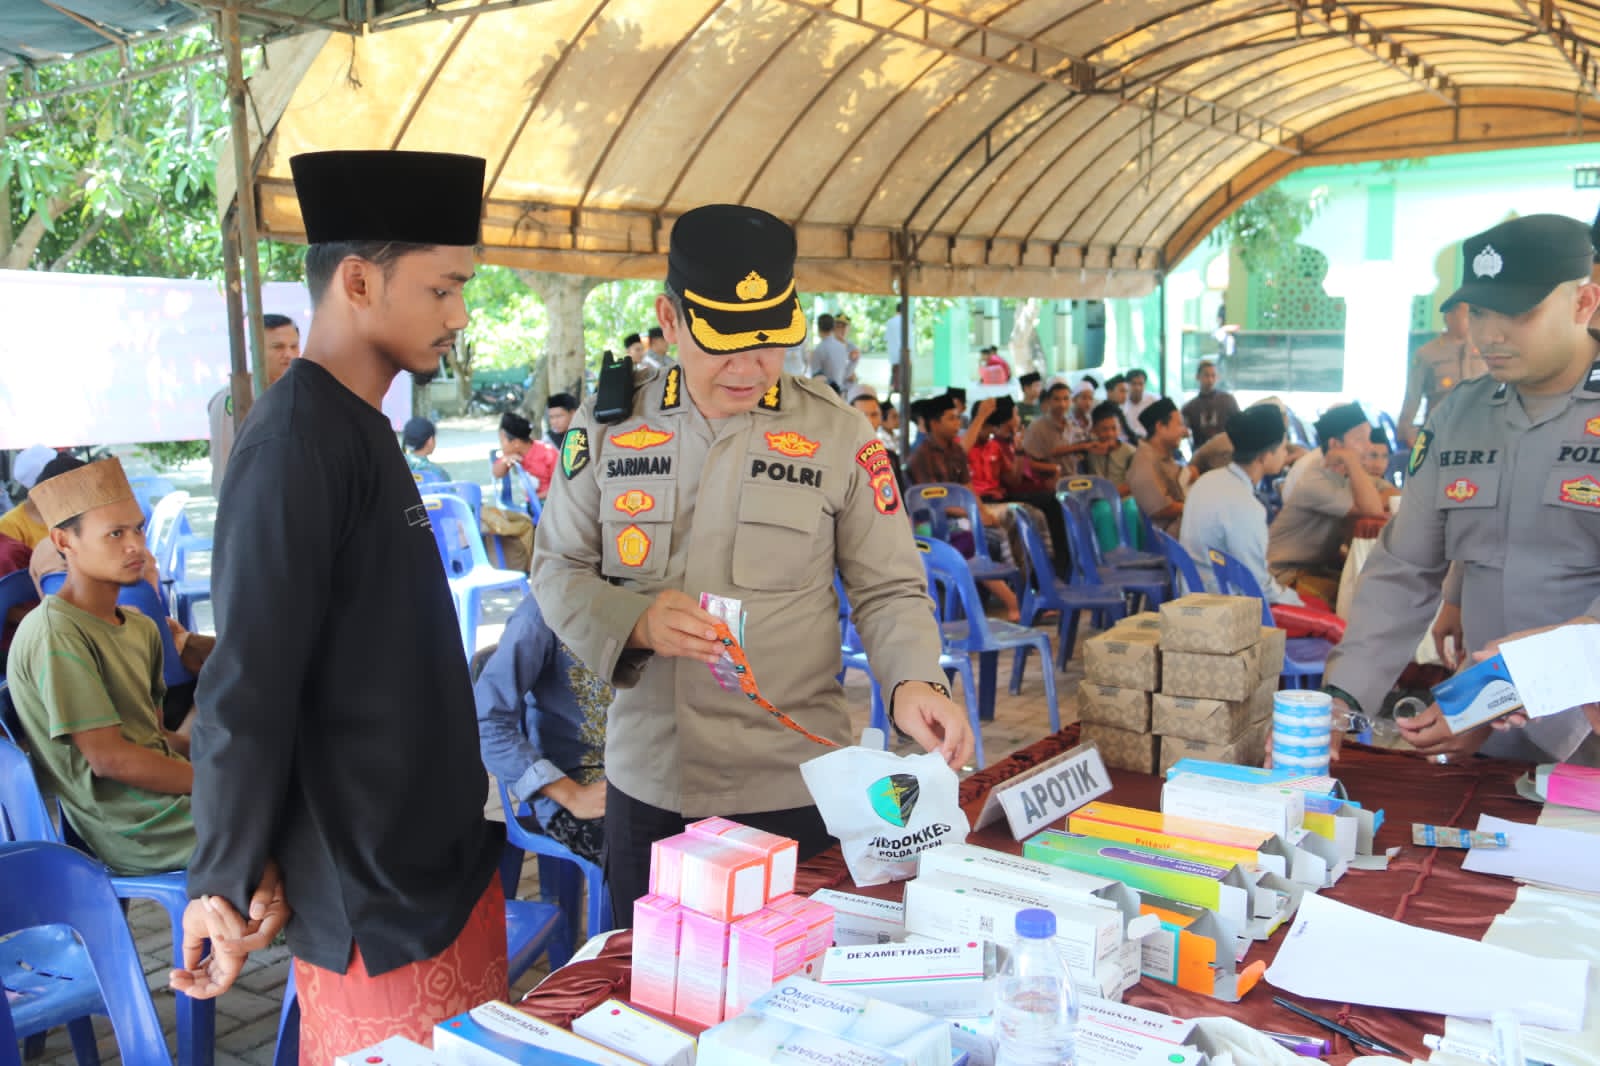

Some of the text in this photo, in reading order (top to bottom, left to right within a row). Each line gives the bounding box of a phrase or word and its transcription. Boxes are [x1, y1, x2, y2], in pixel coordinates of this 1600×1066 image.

[606, 455, 672, 478] SARIMAN
[1439, 449, 1499, 467] HERI
[752, 459, 822, 488] POLRI
[1020, 759, 1099, 824] APOTIK
[879, 847, 913, 858] POLDA
[847, 946, 961, 960] DEXAMETHASONE
